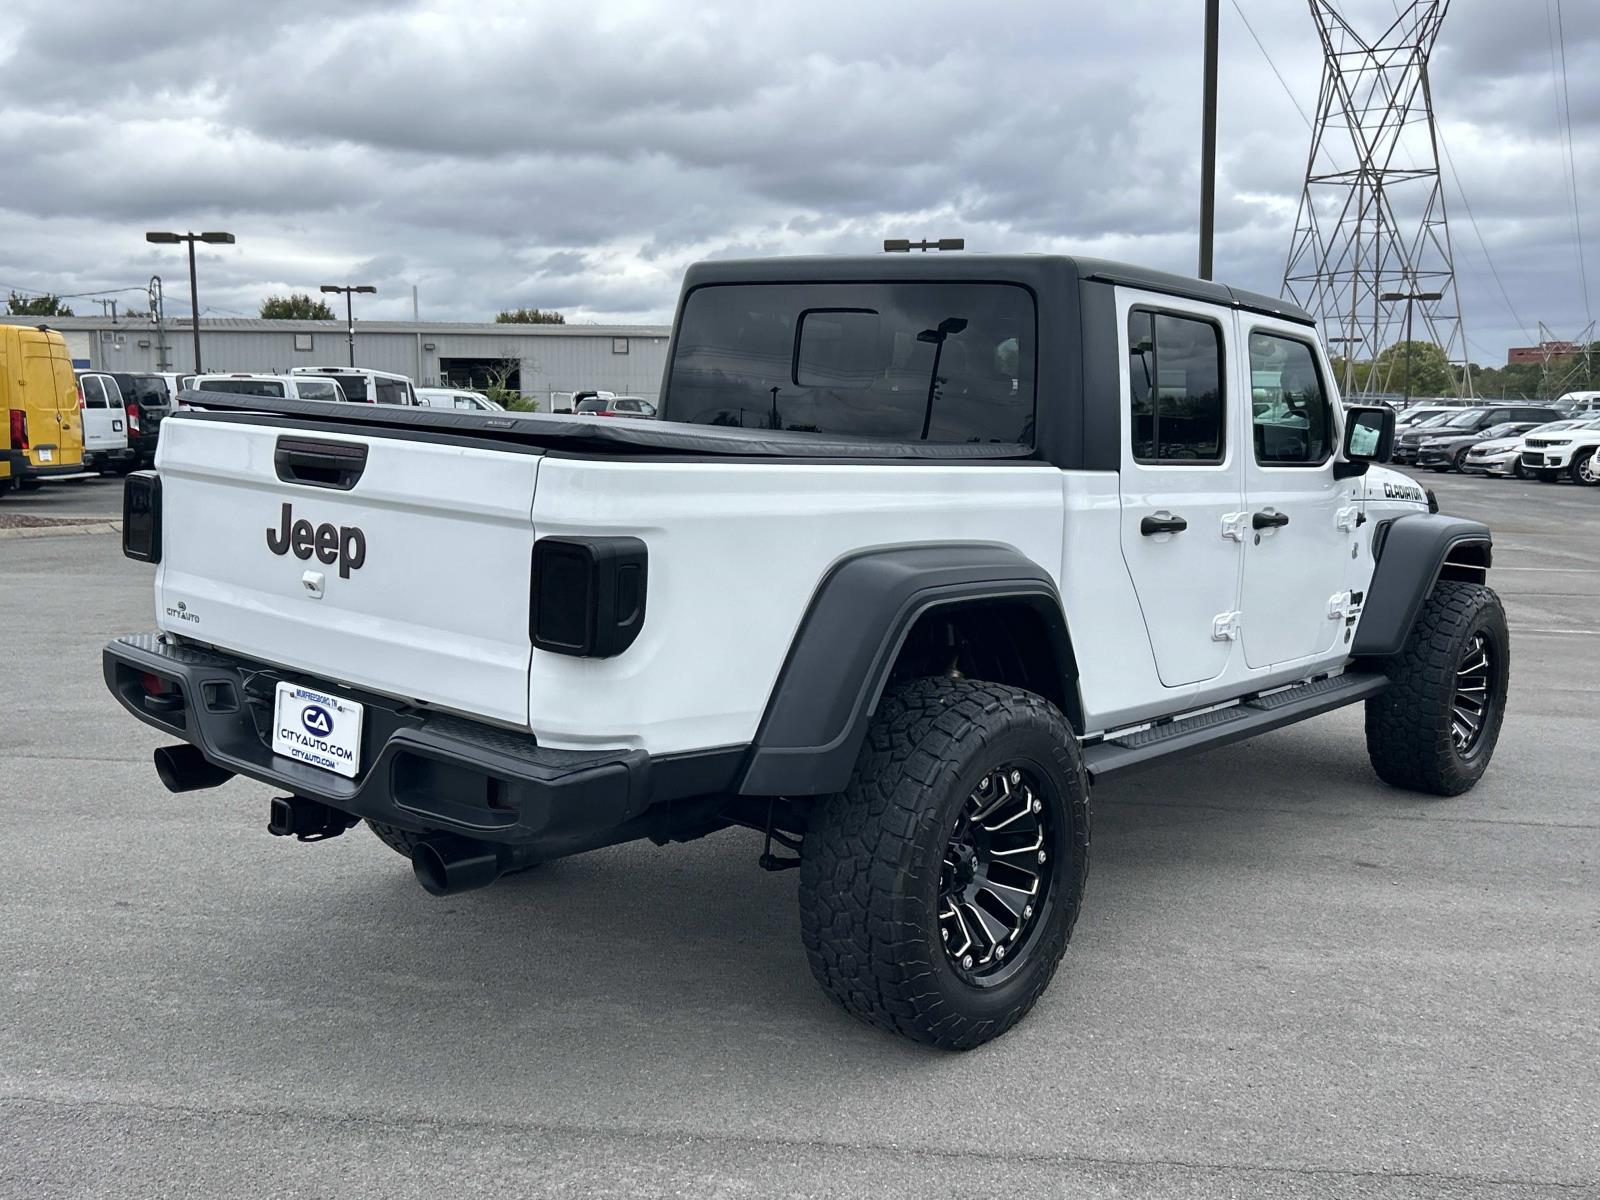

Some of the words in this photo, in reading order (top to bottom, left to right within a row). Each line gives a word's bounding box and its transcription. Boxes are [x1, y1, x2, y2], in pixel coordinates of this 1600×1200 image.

[1383, 483, 1422, 501] GLADIATOR
[266, 502, 366, 579] Jeep
[303, 708, 330, 733] CA
